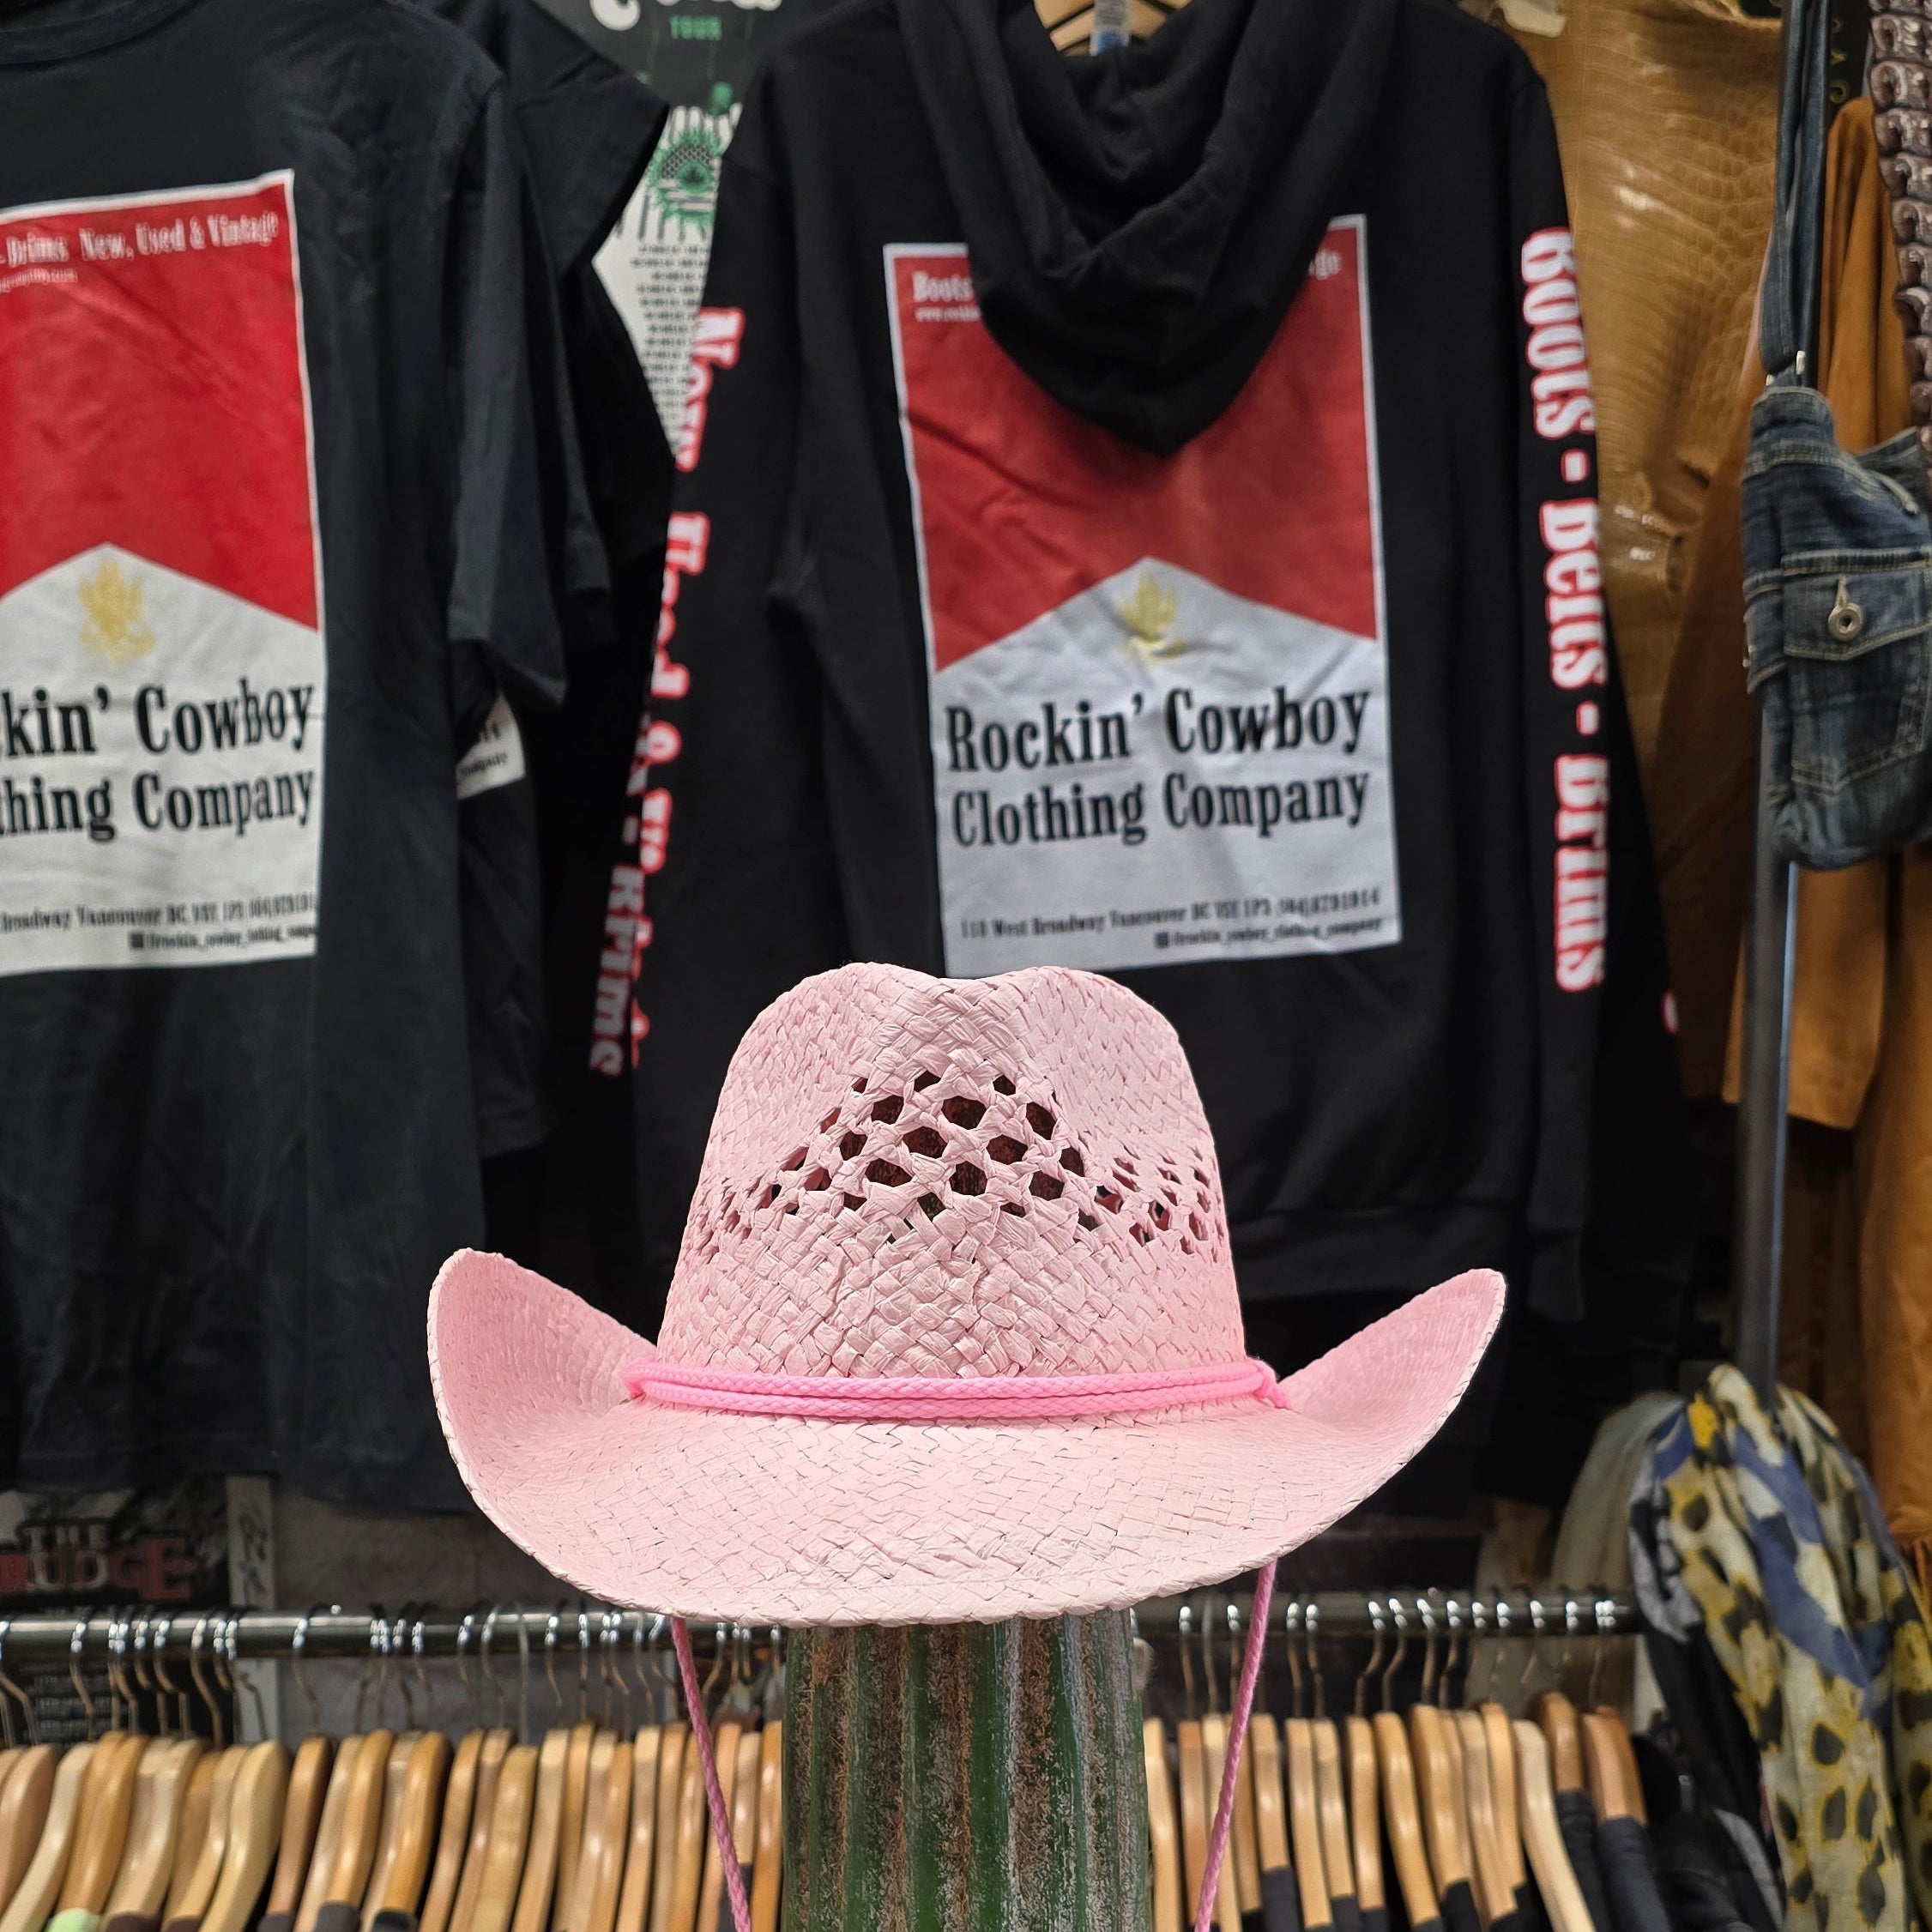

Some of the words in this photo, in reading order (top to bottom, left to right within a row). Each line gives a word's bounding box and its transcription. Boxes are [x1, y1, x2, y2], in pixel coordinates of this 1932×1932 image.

[136, 219, 186, 255] Used
[189, 215, 206, 250] &
[208, 211, 279, 246] Vintage
[0, 684, 109, 758] kin'
[136, 676, 314, 753] Cowboy
[945, 691, 1145, 772] Rockin'
[1164, 685, 1371, 755] Cowboy
[0, 776, 116, 842] hing
[135, 770, 314, 837] Company
[953, 781, 1148, 848] Clothing
[1163, 770, 1371, 837] Company
[75, 903, 161, 928] Vancouver
[166, 901, 185, 926] BC
[992, 917, 1028, 937] West
[1032, 914, 1106, 936] Broadway
[1109, 908, 1186, 927] Vancouver
[1191, 901, 1211, 921] BC
